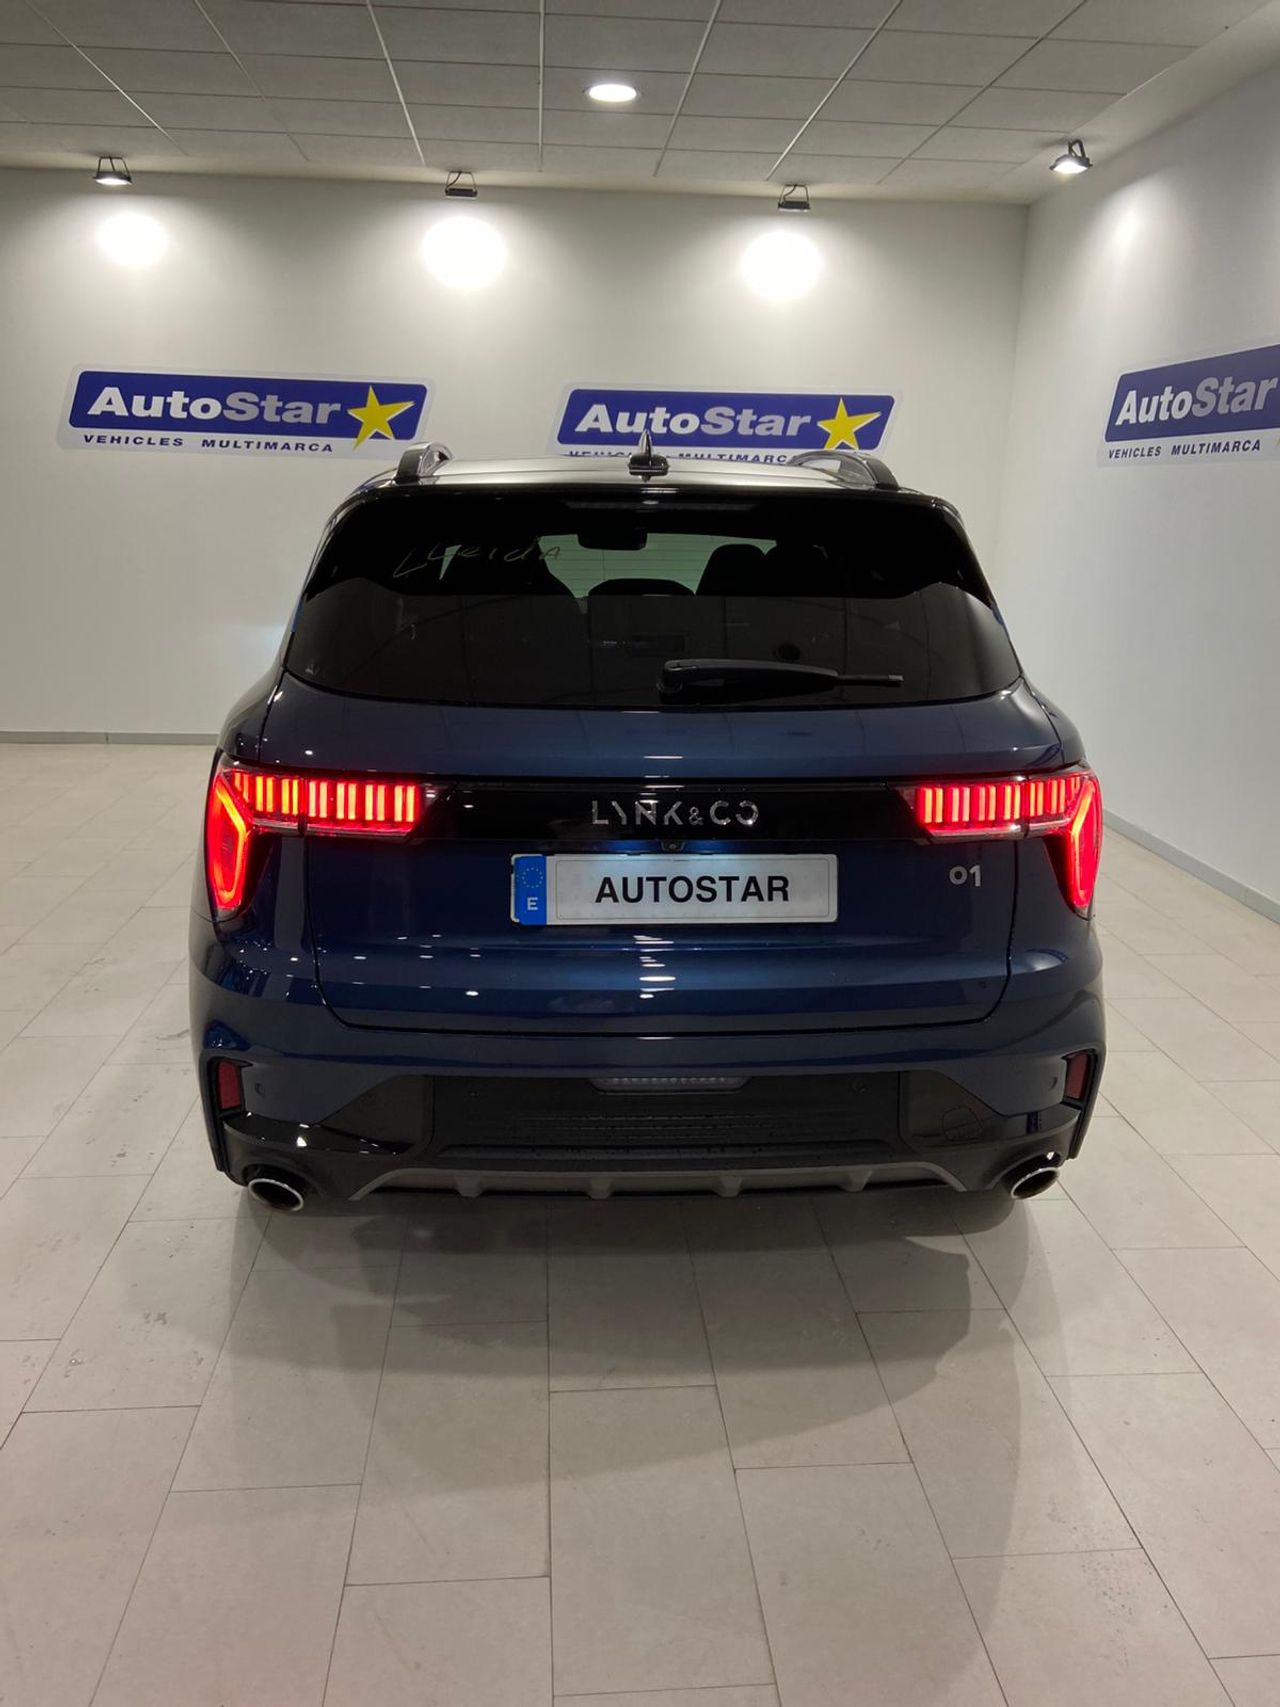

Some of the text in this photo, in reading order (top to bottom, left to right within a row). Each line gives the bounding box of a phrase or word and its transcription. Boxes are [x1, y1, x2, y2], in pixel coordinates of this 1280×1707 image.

[87, 386, 341, 424] AutoStar
[1115, 376, 1279, 426] AutoStar
[575, 403, 812, 436] AutoStar
[84, 434, 333, 453] VEHICLES MULTIMARCA
[1108, 439, 1261, 459] VEHICLES MULTIMARCA
[594, 875, 790, 903] AUTOSTAR
[527, 896, 539, 911] E
